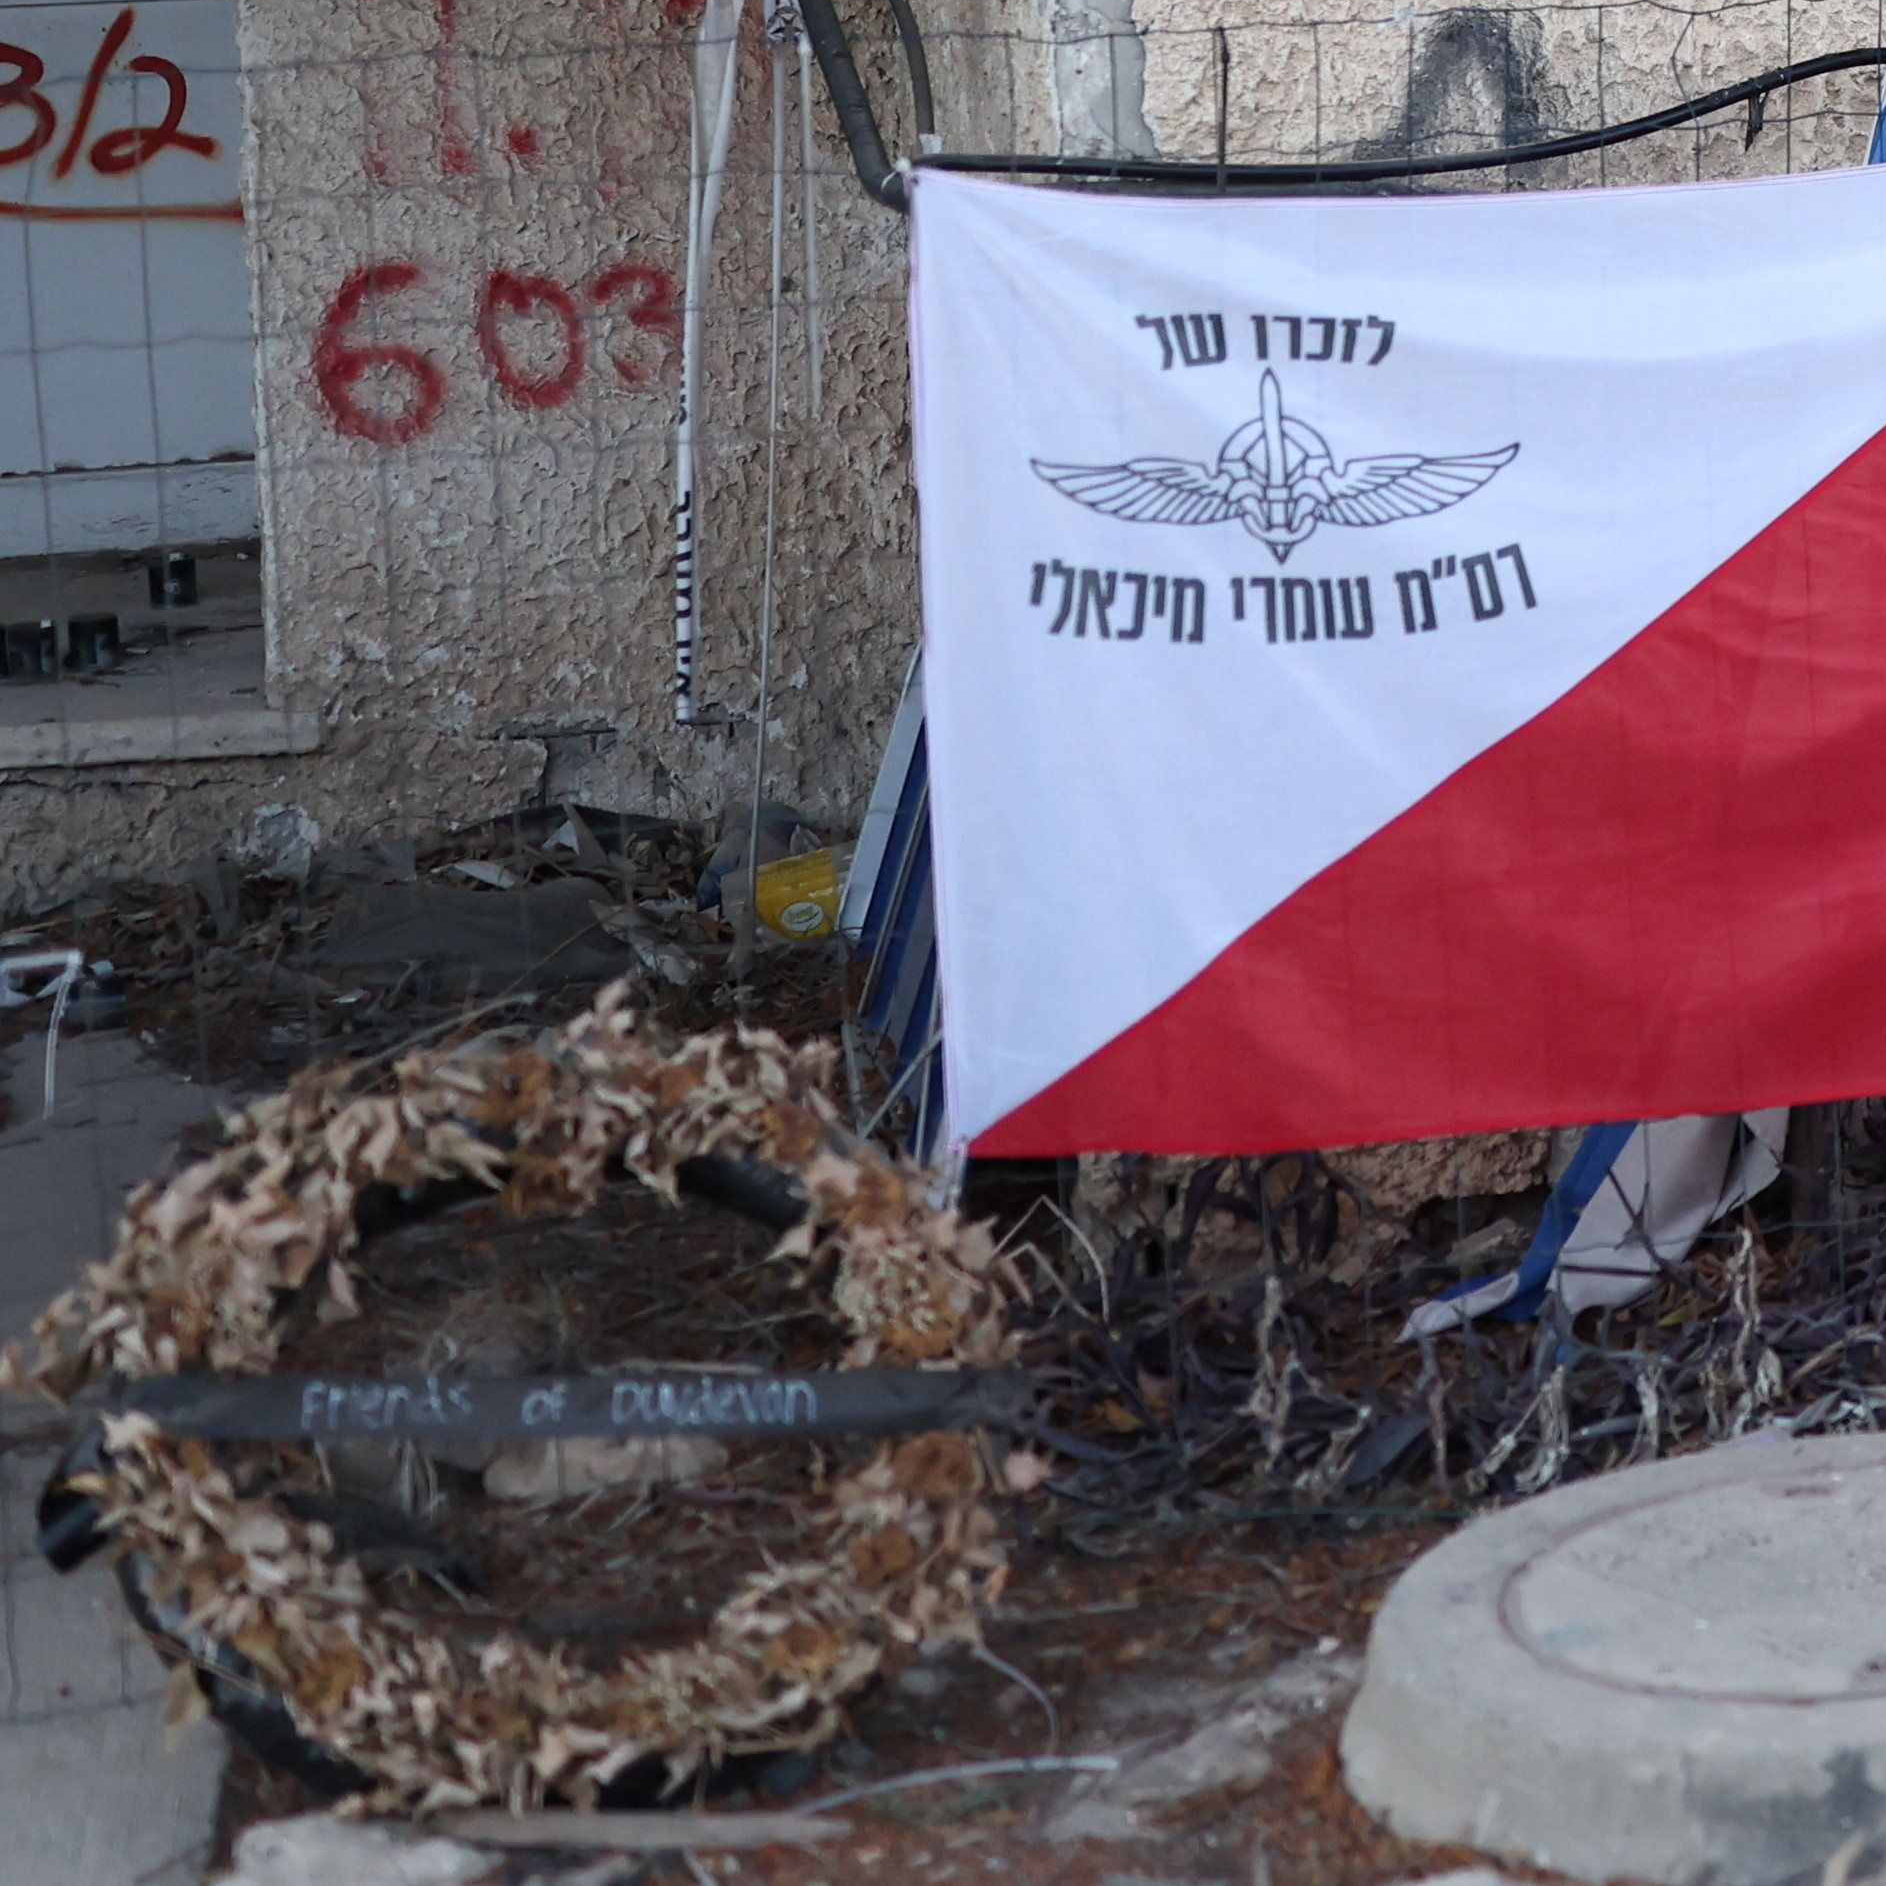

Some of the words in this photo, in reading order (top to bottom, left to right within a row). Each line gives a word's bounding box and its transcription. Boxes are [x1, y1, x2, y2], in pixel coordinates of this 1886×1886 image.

[312, 261, 684, 446] 603
[1134, 311, 1227, 371] של
[1250, 313, 1397, 367] לזכרו
[1028, 558, 1207, 643] מיכאלי
[1231, 575, 1376, 645] עומרי
